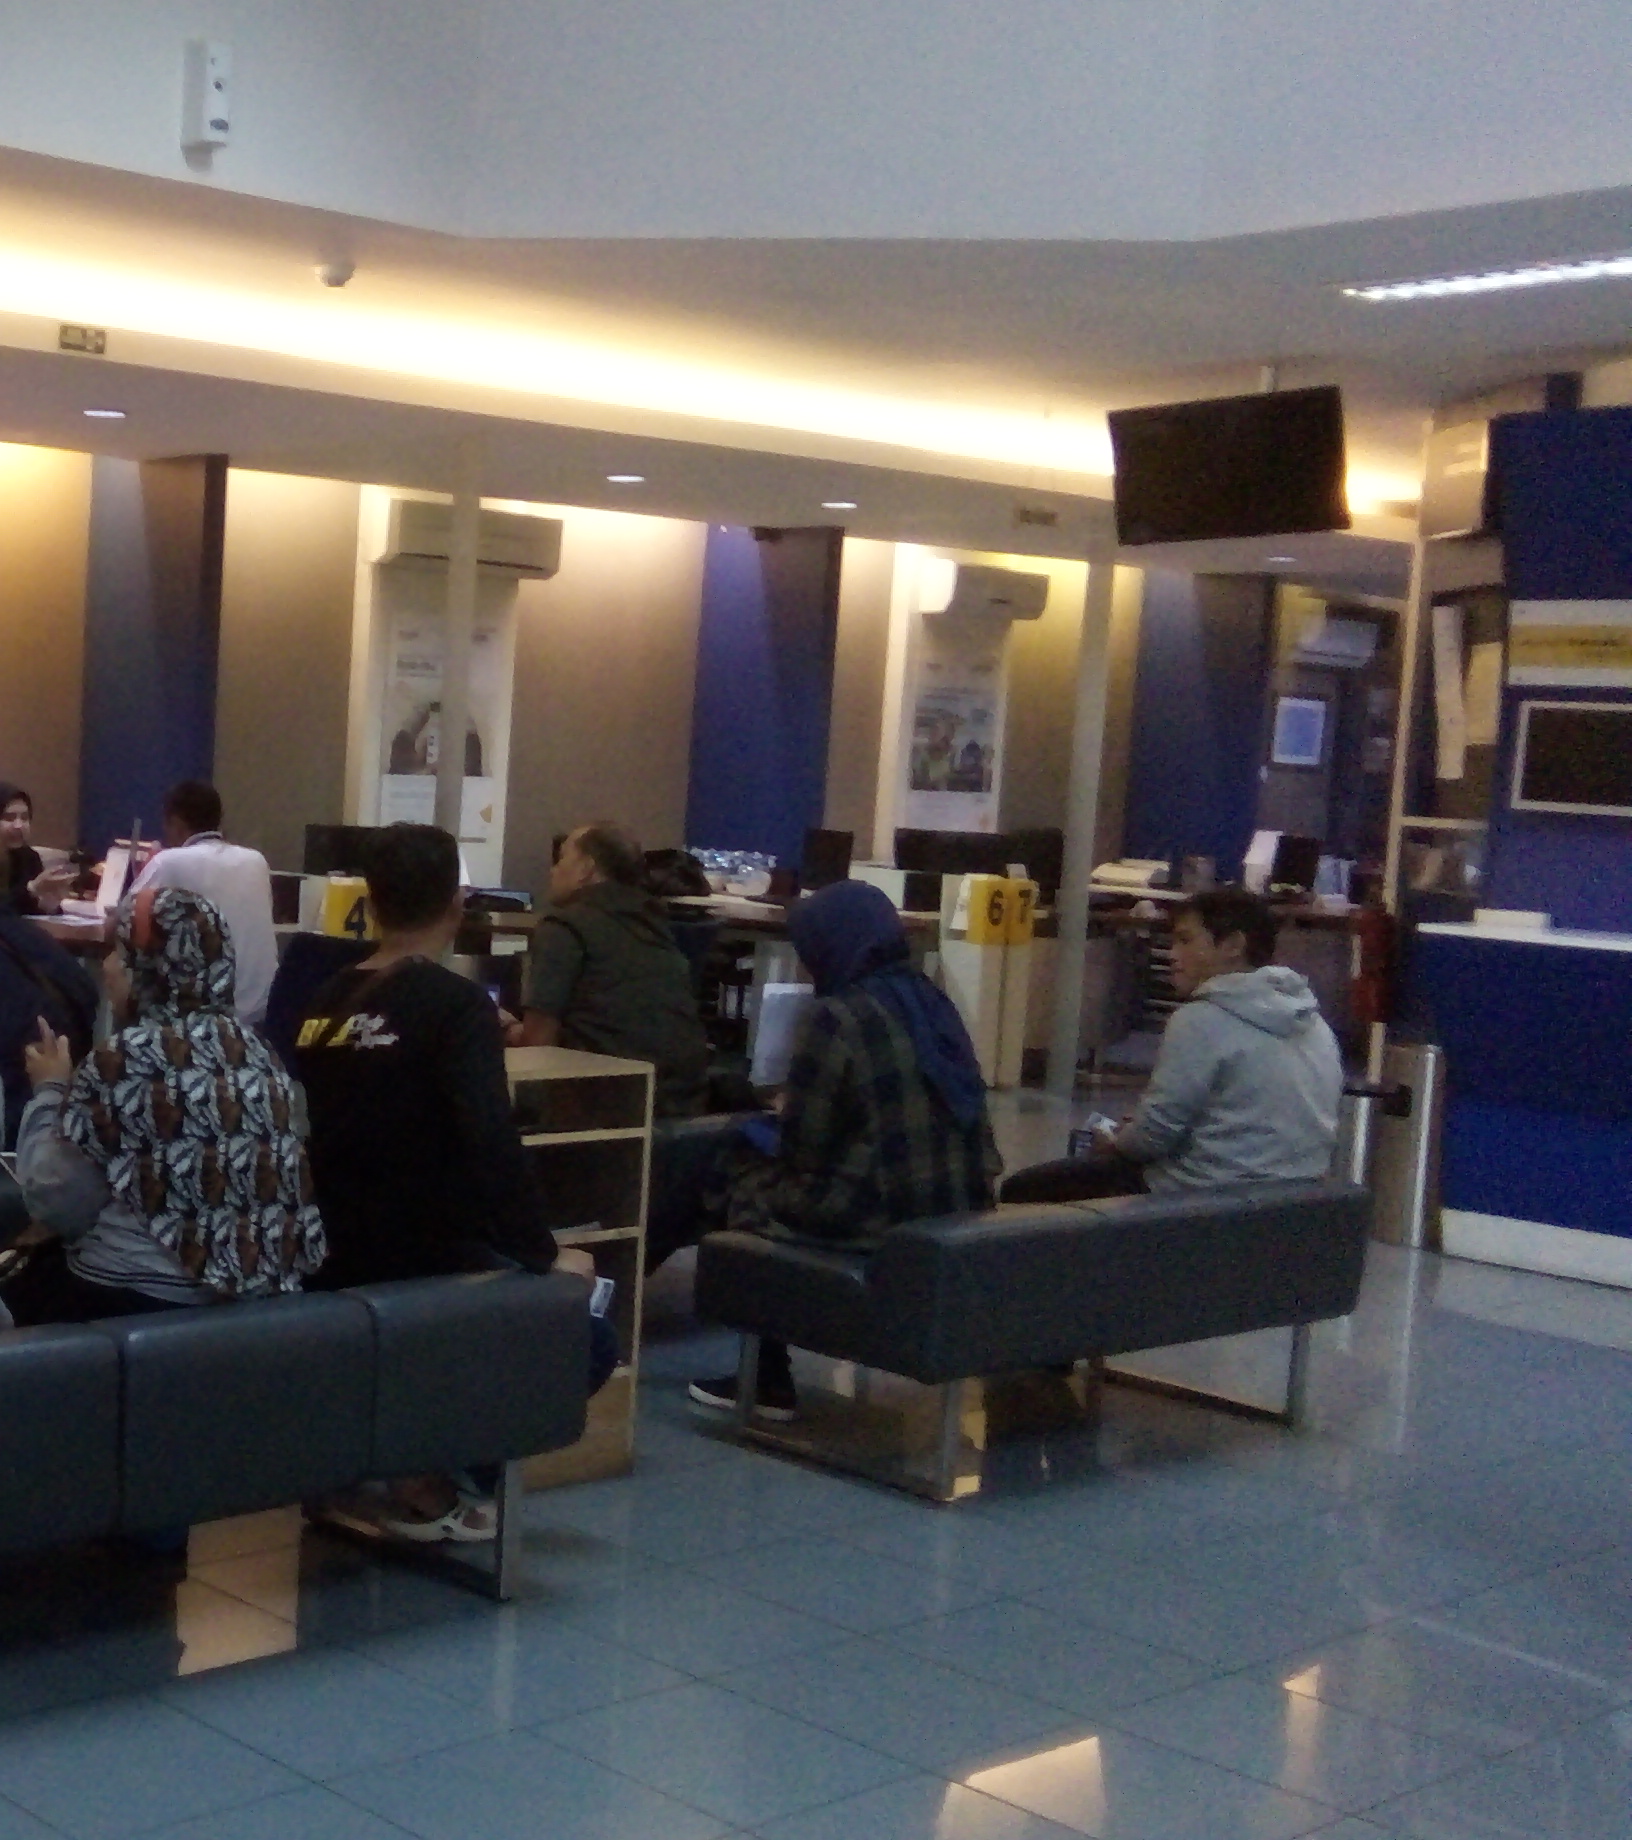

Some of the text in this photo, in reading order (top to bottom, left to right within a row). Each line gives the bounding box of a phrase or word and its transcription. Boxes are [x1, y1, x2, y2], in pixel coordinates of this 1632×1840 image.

[344, 896, 367, 940] 4
[987, 889, 1005, 926] 6
[1018, 889, 1032, 924] 7
